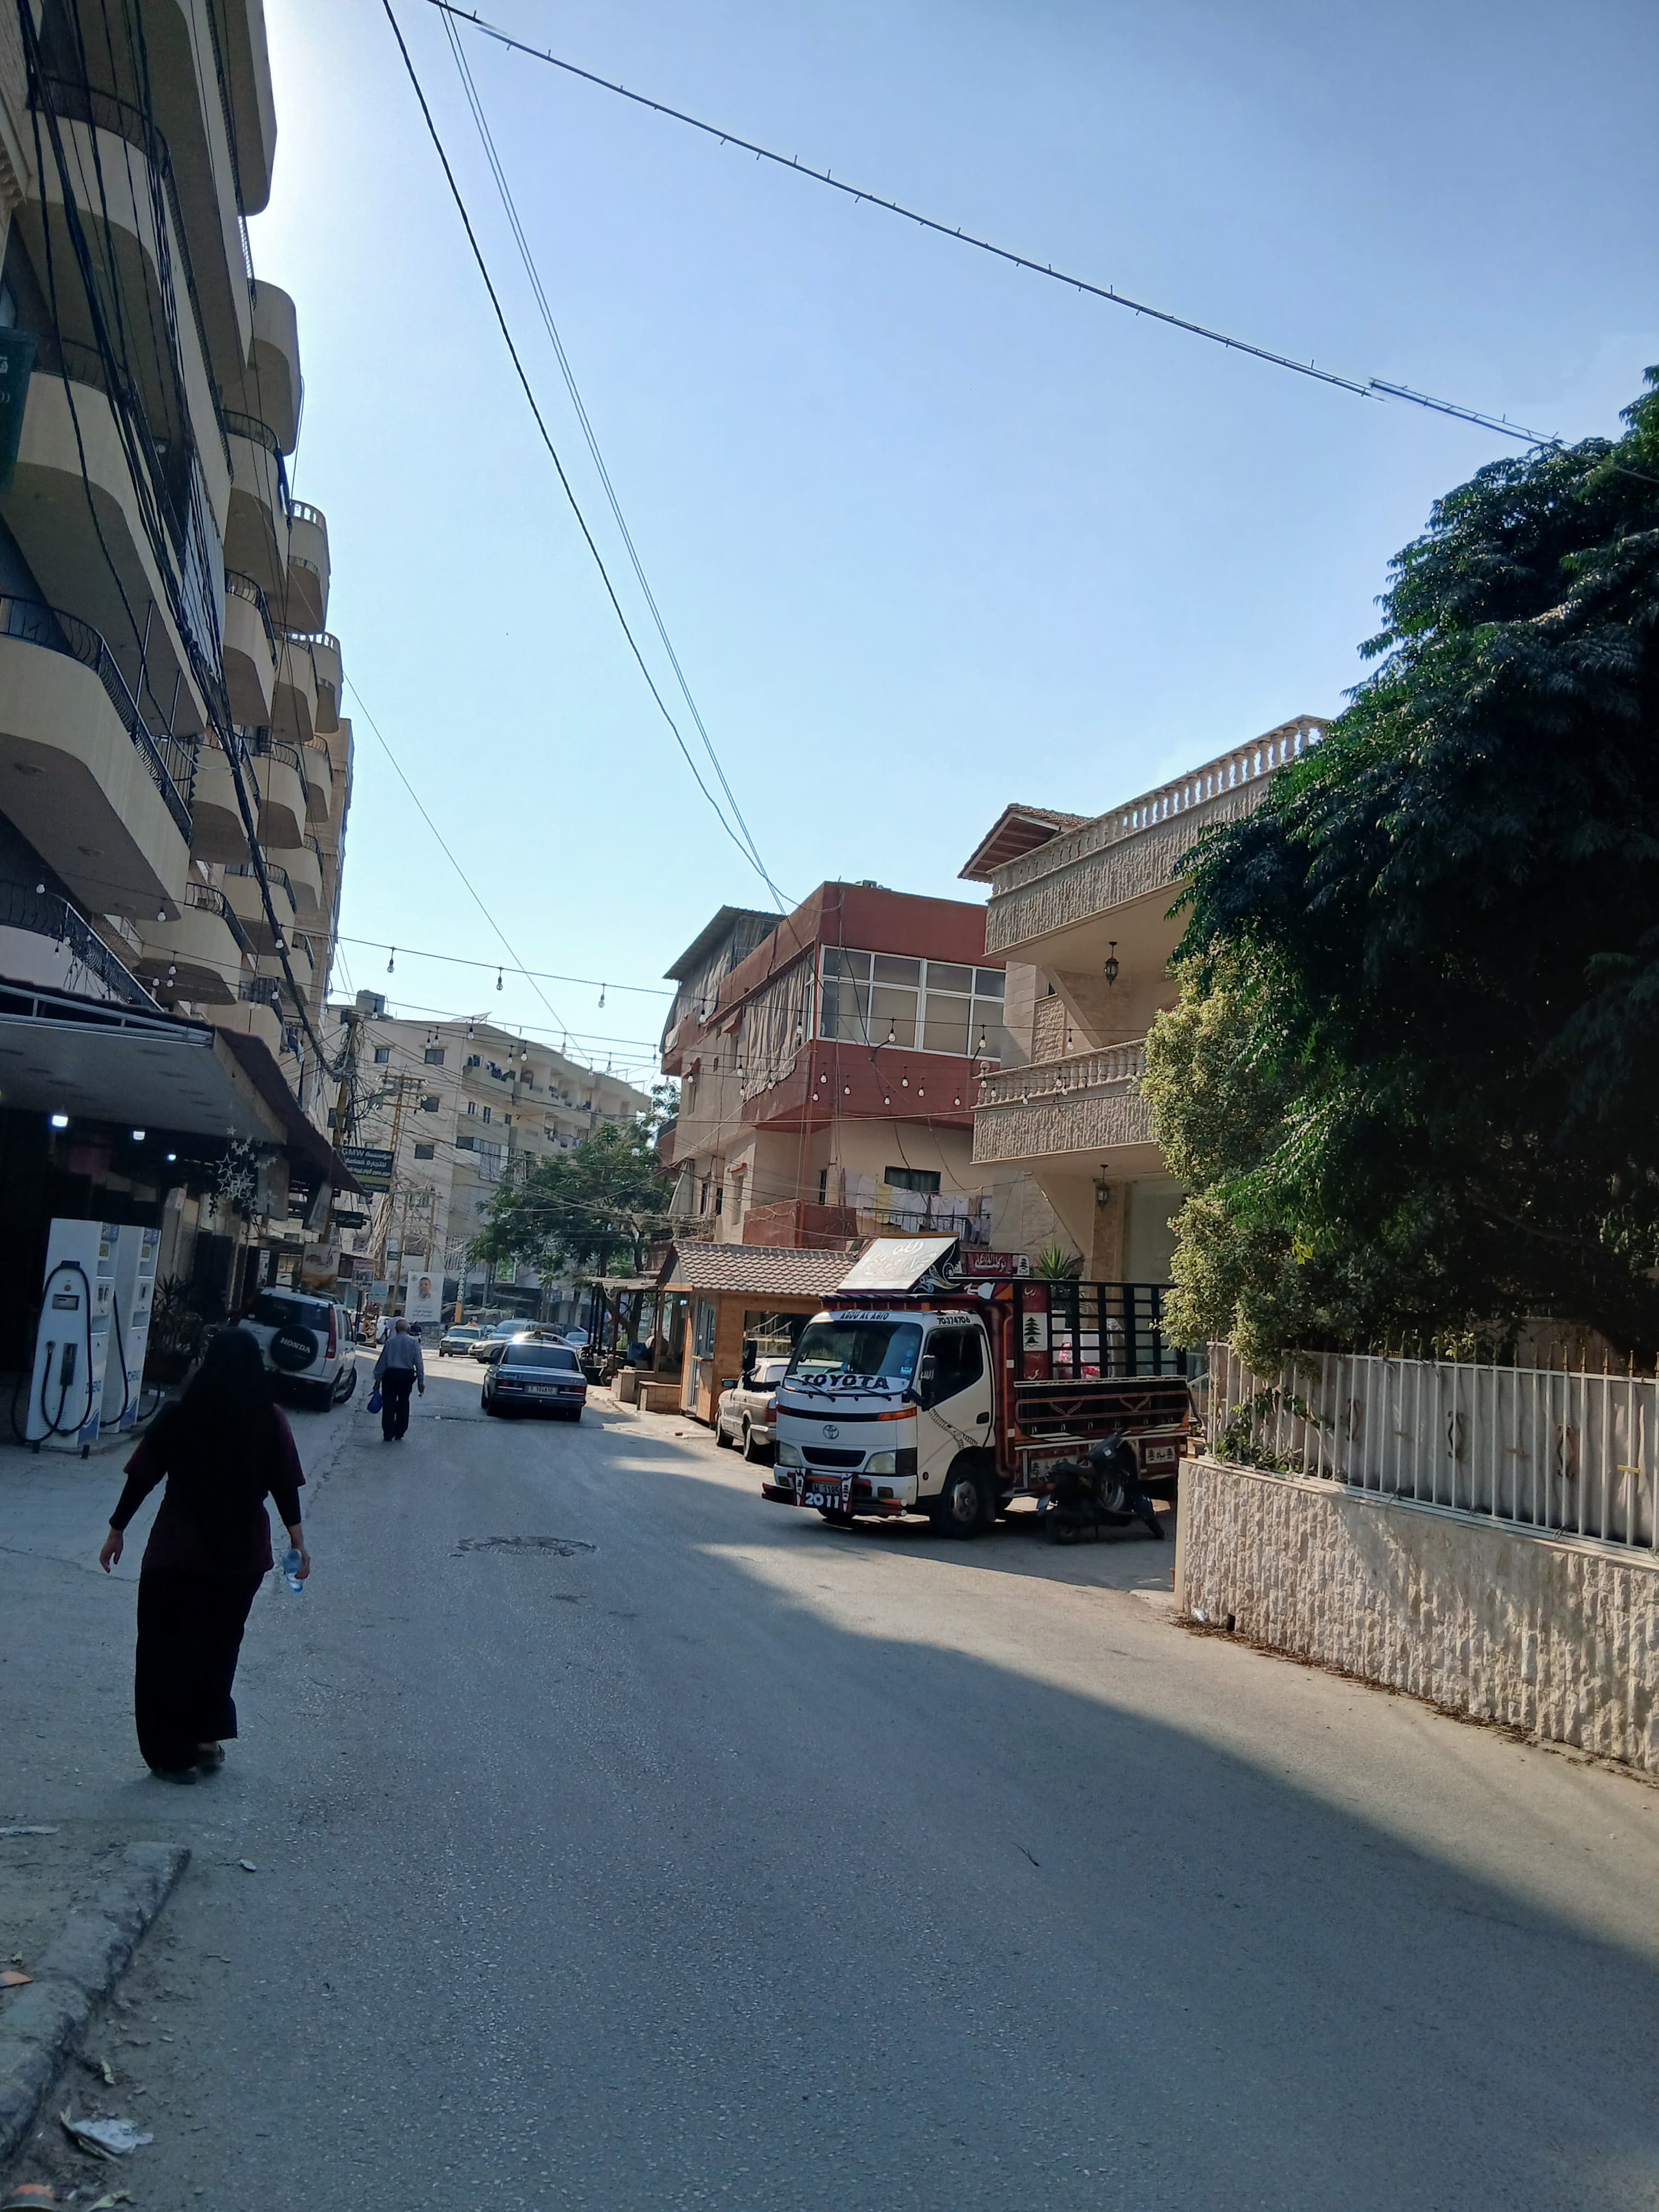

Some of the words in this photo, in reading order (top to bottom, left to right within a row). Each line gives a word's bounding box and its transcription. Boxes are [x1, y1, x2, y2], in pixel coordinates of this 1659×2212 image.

[342, 1148, 364, 1157] GMW
[365, 1152, 392, 1160] مؤسسة
[280, 1337, 311, 1354] HONDA
[801, 1374, 890, 1390] TOYOTA
[805, 1492, 840, 1508] 2011
